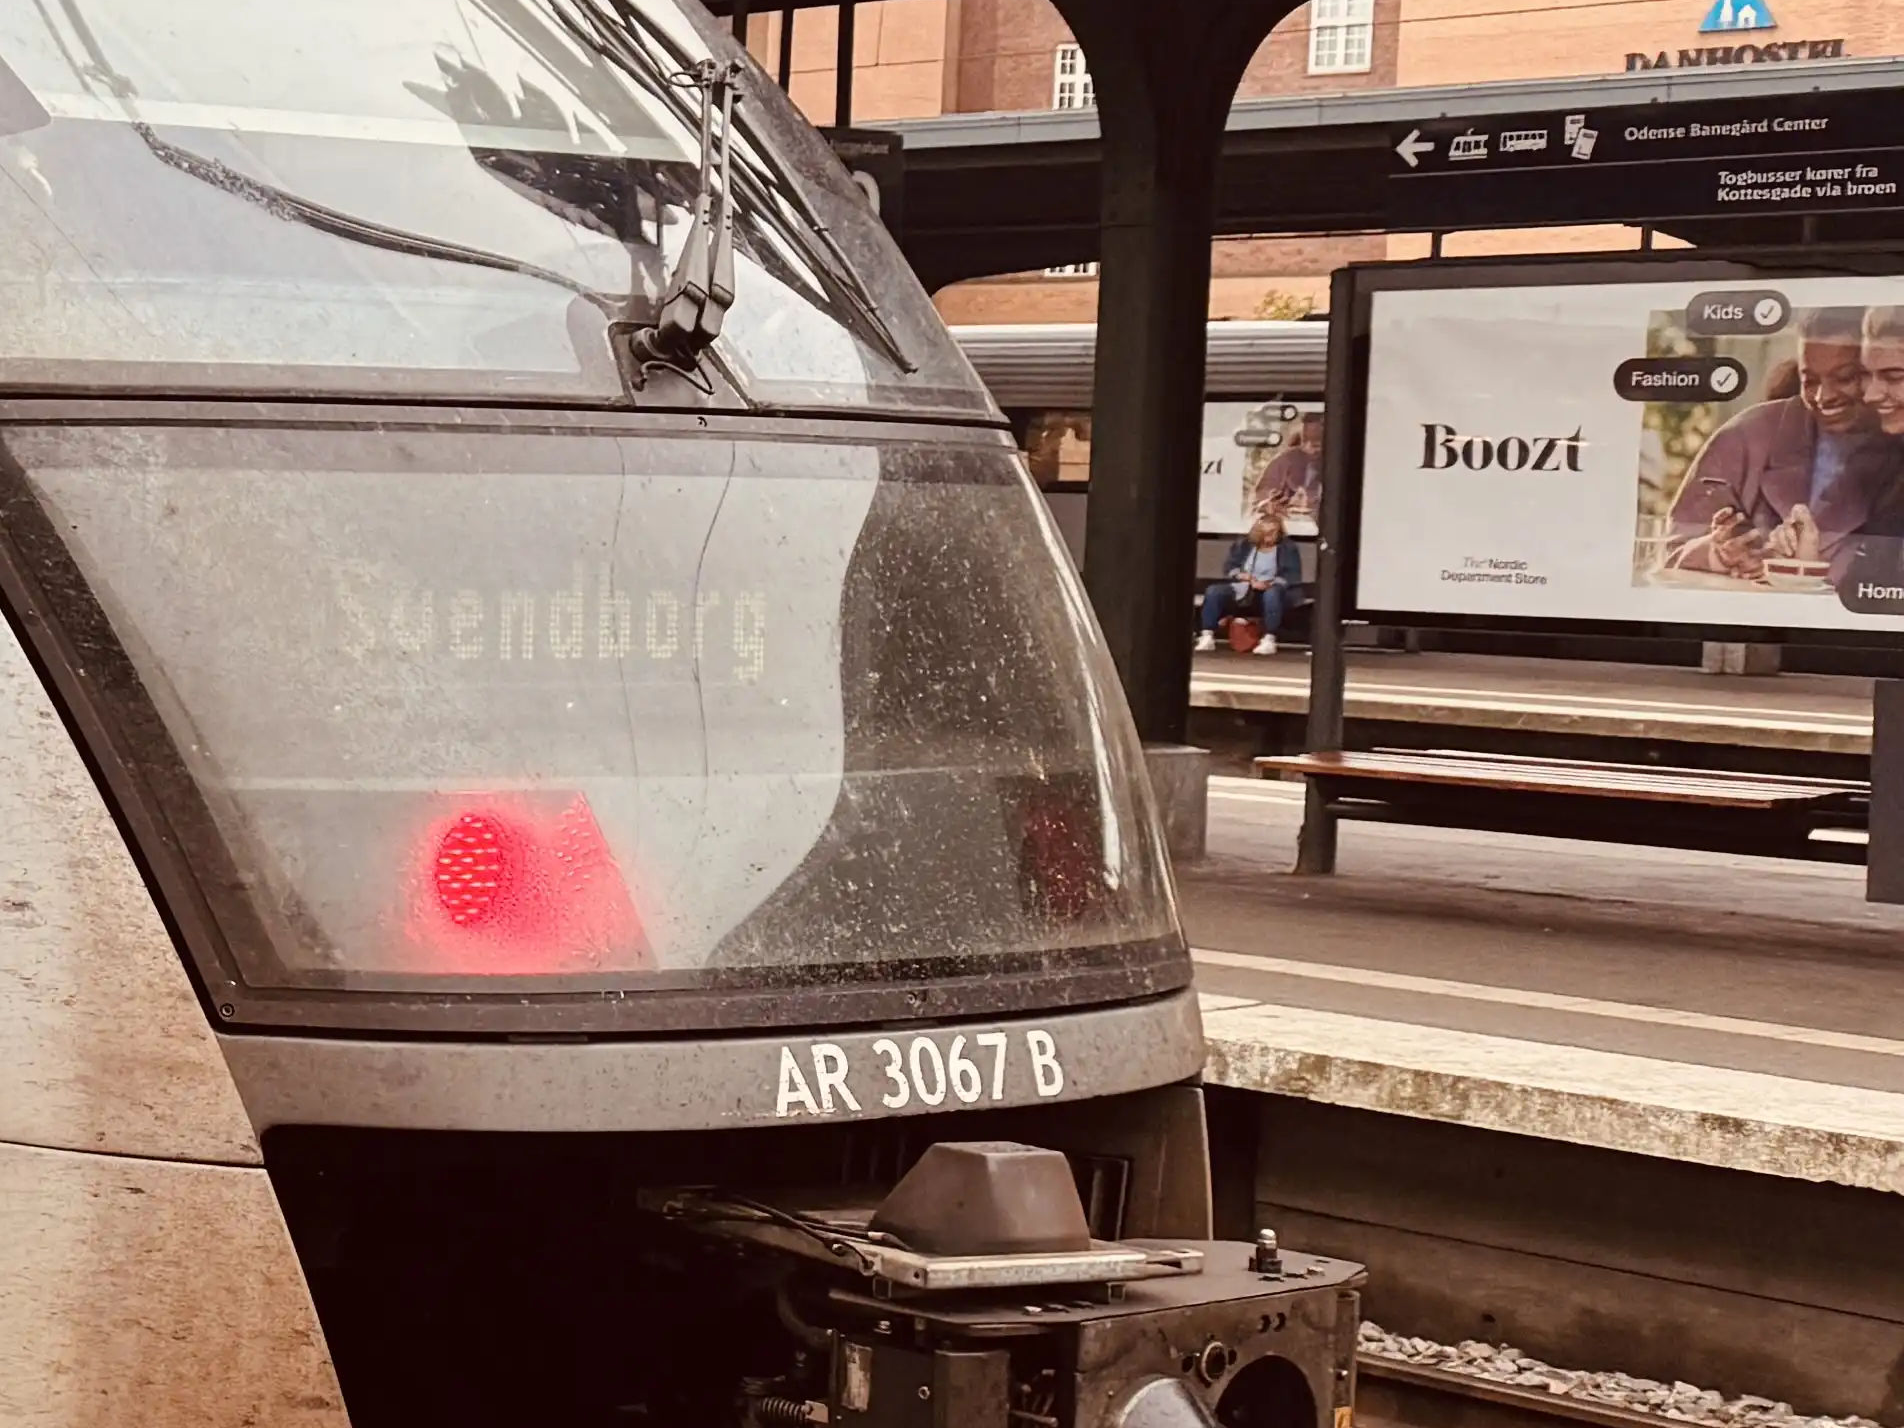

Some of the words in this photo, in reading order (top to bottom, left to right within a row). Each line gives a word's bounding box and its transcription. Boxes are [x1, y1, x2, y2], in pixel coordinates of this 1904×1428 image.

[1624, 125, 1687, 142] Odense
[1689, 118, 1769, 138] Banegård
[1772, 117, 1830, 133] Center
[1717, 169, 1803, 186] Togbusser
[1855, 163, 1879, 179] fra
[1815, 183, 1842, 198] via
[1846, 181, 1897, 196] broen
[1703, 303, 1745, 321] Kids
[1631, 371, 1700, 388] Fashion
[1416, 423, 1585, 472] Boozt
[1488, 557, 1529, 571] Nordic
[1441, 569, 1514, 584] Department
[1514, 572, 1548, 585] Store
[775, 1043, 862, 1117] AR
[872, 1032, 1008, 1109] 3067
[1026, 1030, 1064, 1097] B
